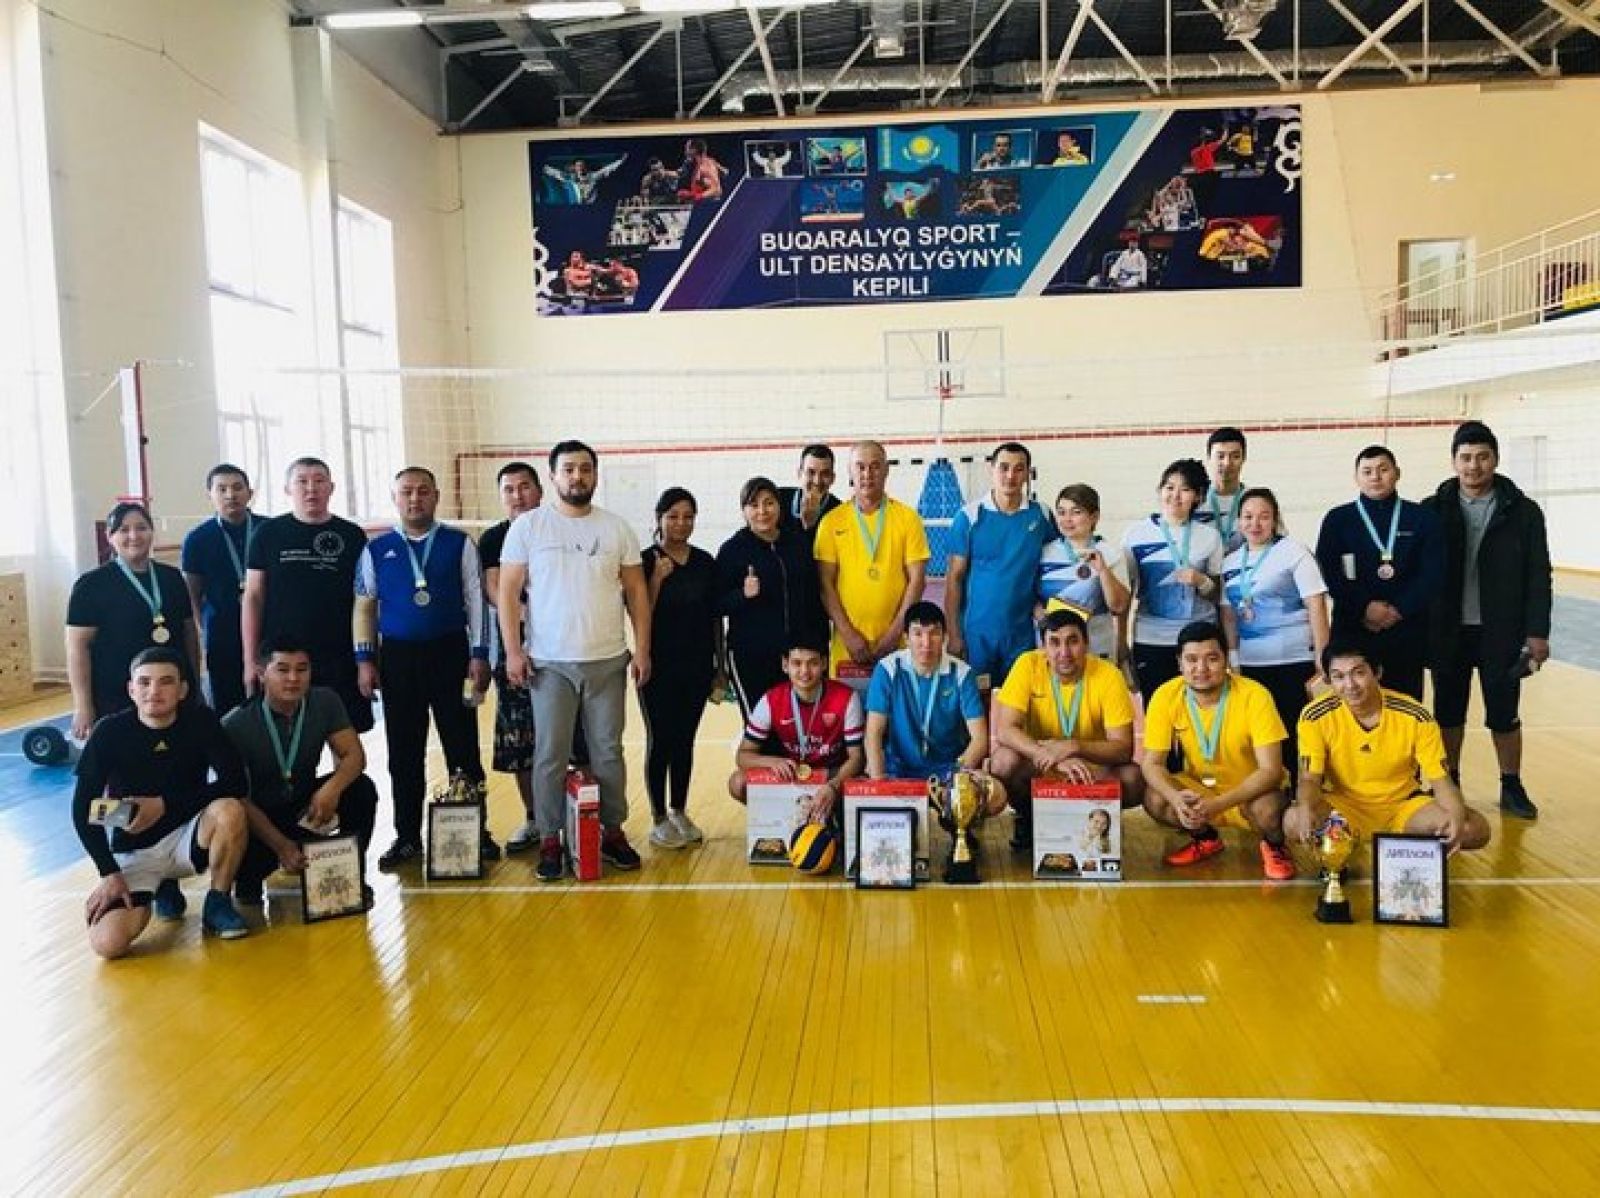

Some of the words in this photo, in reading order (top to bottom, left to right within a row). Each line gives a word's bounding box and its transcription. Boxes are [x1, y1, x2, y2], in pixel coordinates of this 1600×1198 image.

[760, 227, 910, 252] BUQARALYQ
[917, 223, 1000, 246] SPORT
[759, 256, 803, 277] ULT
[852, 276, 930, 297] KEPILI
